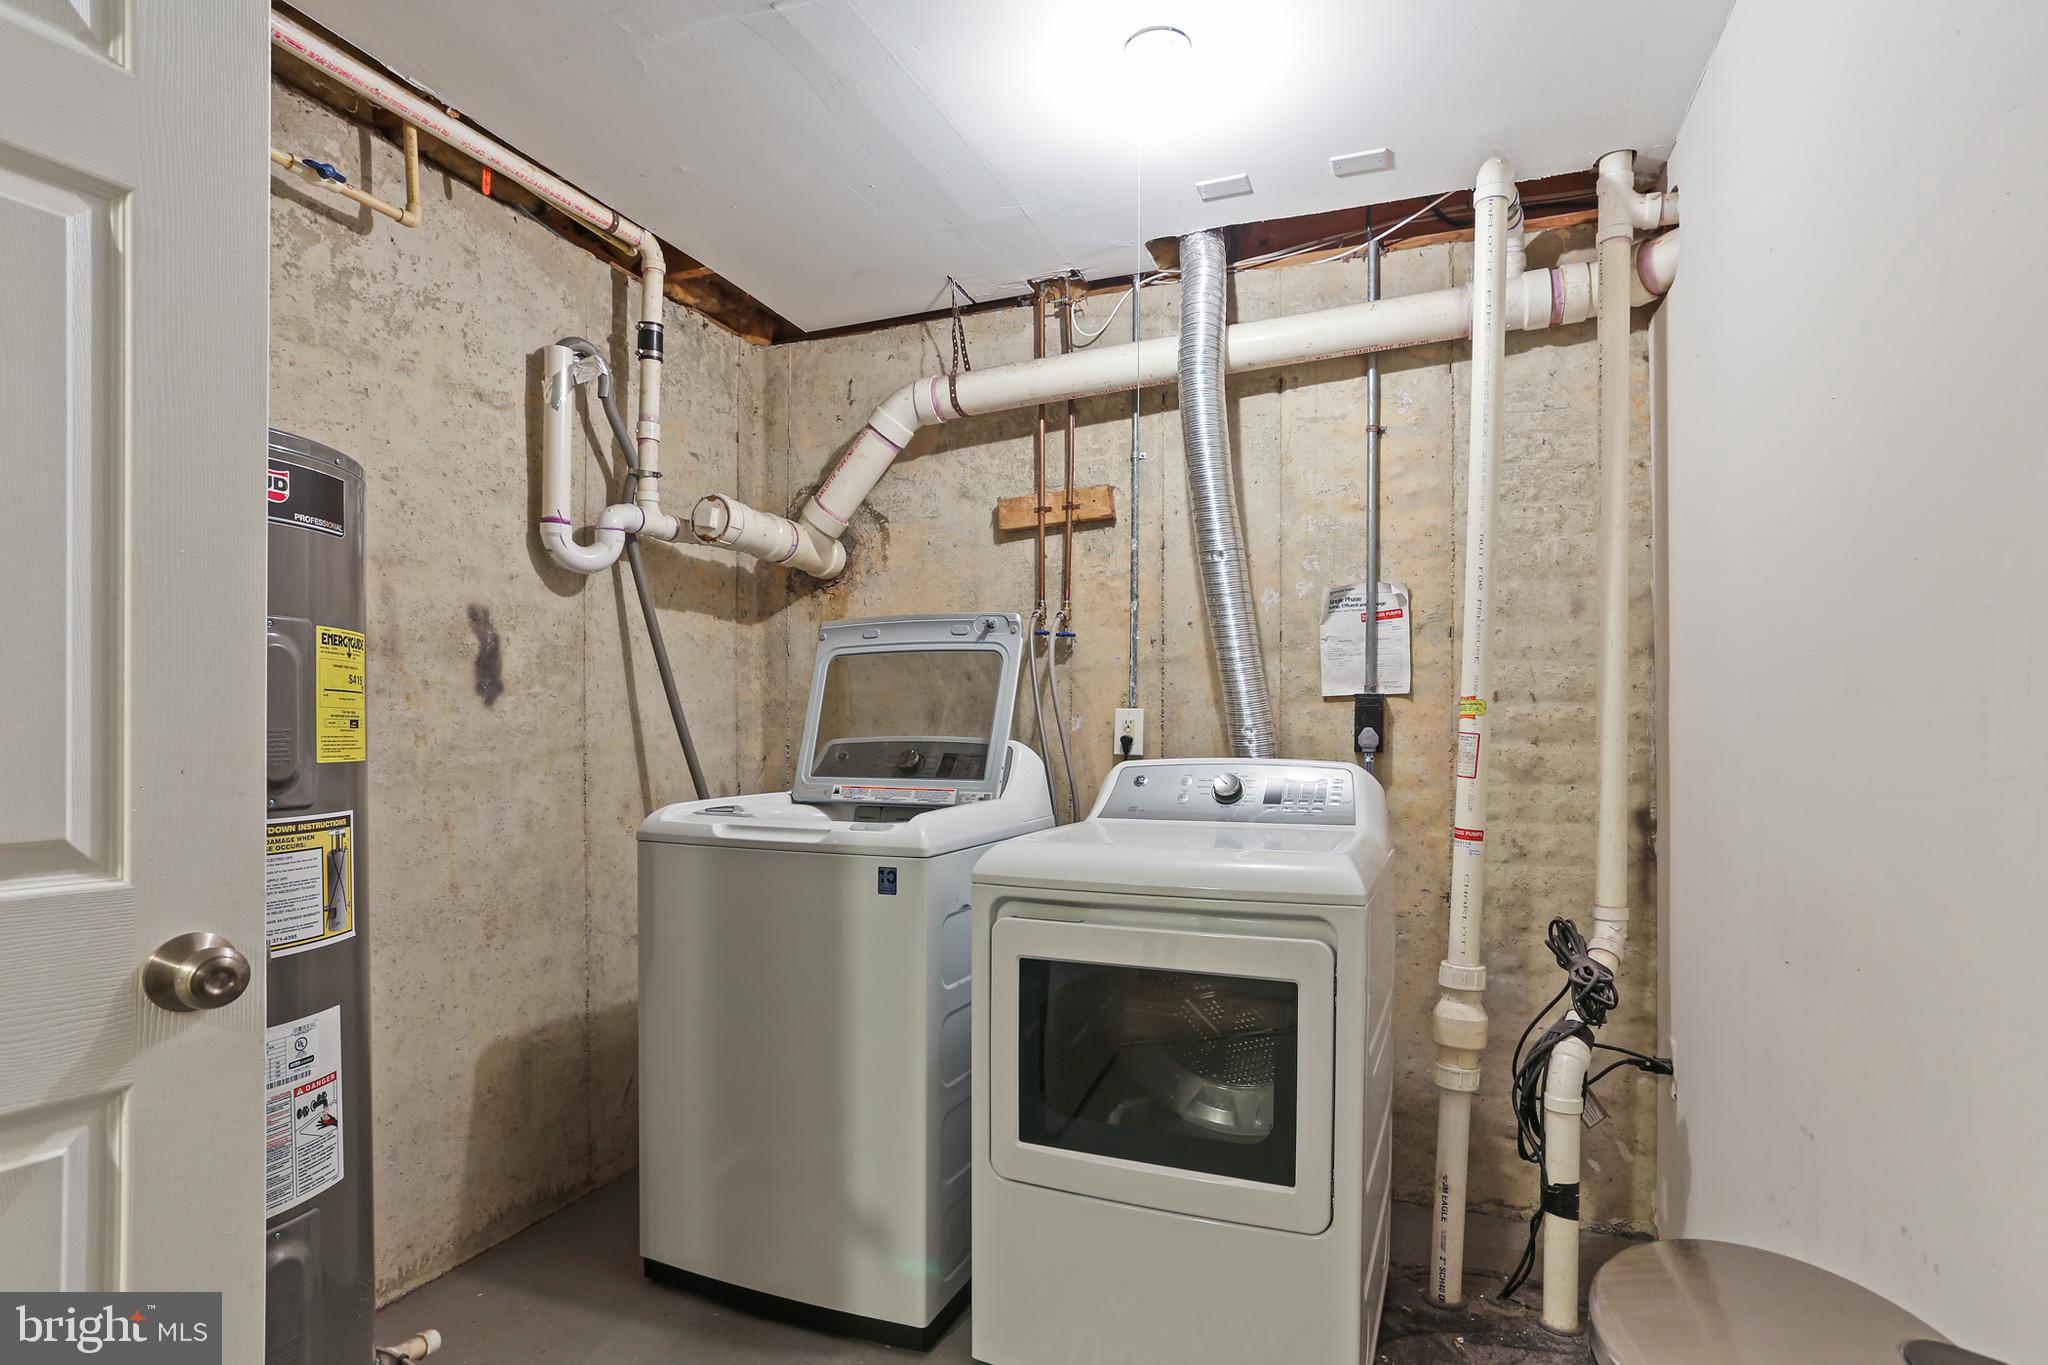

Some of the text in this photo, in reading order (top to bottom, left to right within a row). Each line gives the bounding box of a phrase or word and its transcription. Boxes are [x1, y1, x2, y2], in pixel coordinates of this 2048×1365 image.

[294, 513, 343, 532] PROFESSIONAL
[298, 818, 346, 830] INSTRUCTIONS
[275, 842, 305, 851] OCCURS:
[305, 1074, 336, 1091] DANGER
